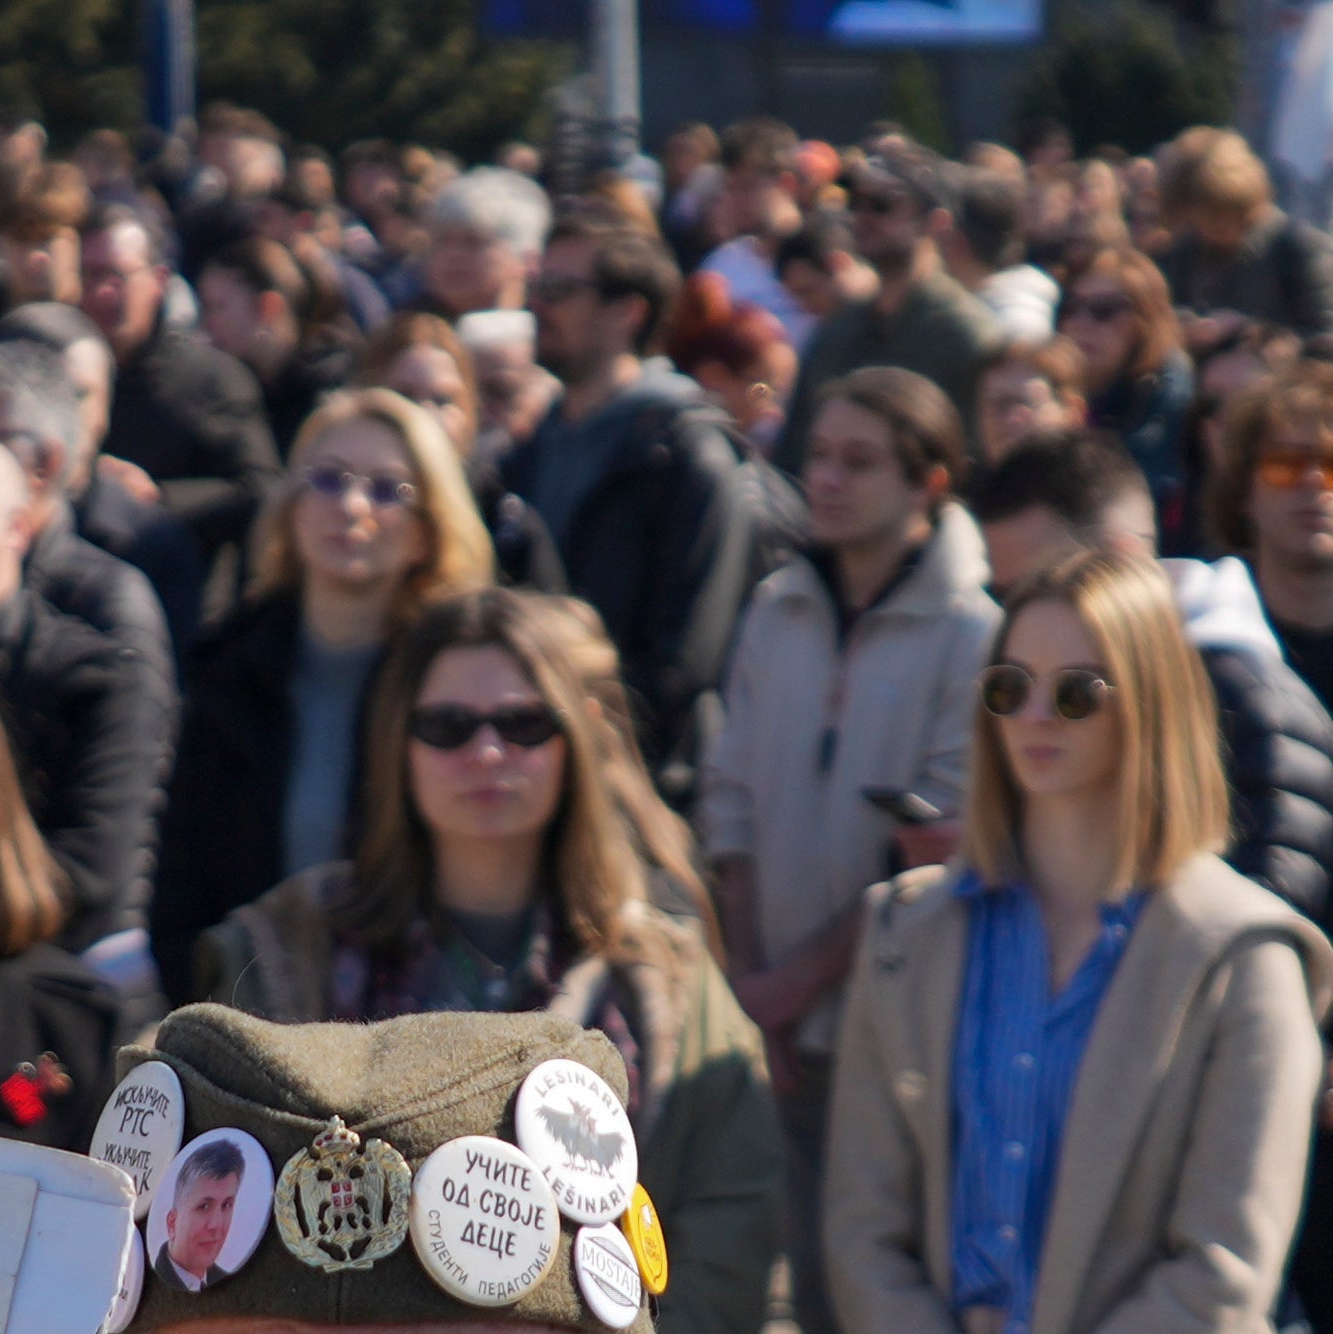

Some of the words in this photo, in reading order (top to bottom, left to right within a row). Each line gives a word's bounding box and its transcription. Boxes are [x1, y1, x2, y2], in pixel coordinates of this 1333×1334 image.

[119, 1106, 154, 1136] РТС
[466, 1149, 532, 1191] УЧИТЕ
[542, 1165, 626, 1214] LEŠINARI
[442, 1177, 469, 1208] ОД
[480, 1189, 546, 1230] СВОЈЕ
[429, 1209, 469, 1285] СТУДЕНТИ
[478, 1242, 551, 1299] ПЕДАГОГИЈЕ
[461, 1219, 517, 1259] ДЕЦЕ
